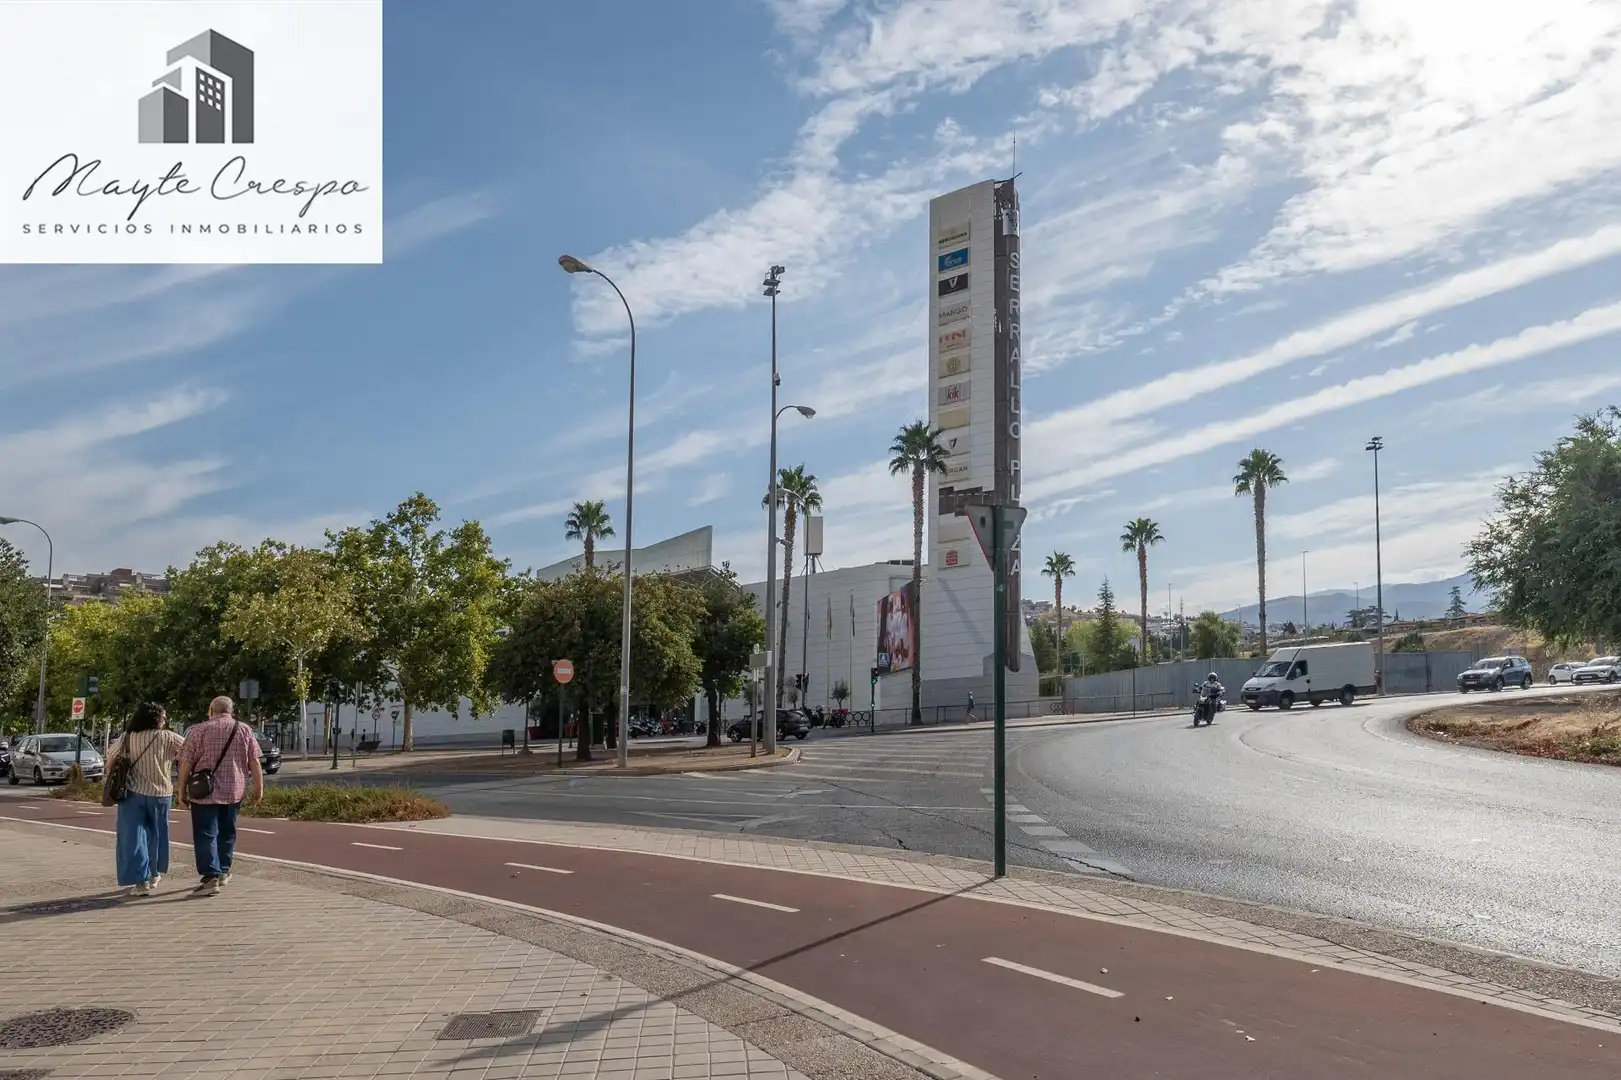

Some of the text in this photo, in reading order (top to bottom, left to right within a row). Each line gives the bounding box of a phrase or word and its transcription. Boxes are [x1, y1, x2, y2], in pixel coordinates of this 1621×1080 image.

[939, 305, 968, 318] MANGO
[1009, 252, 1021, 576] SERRALLO PLZA
